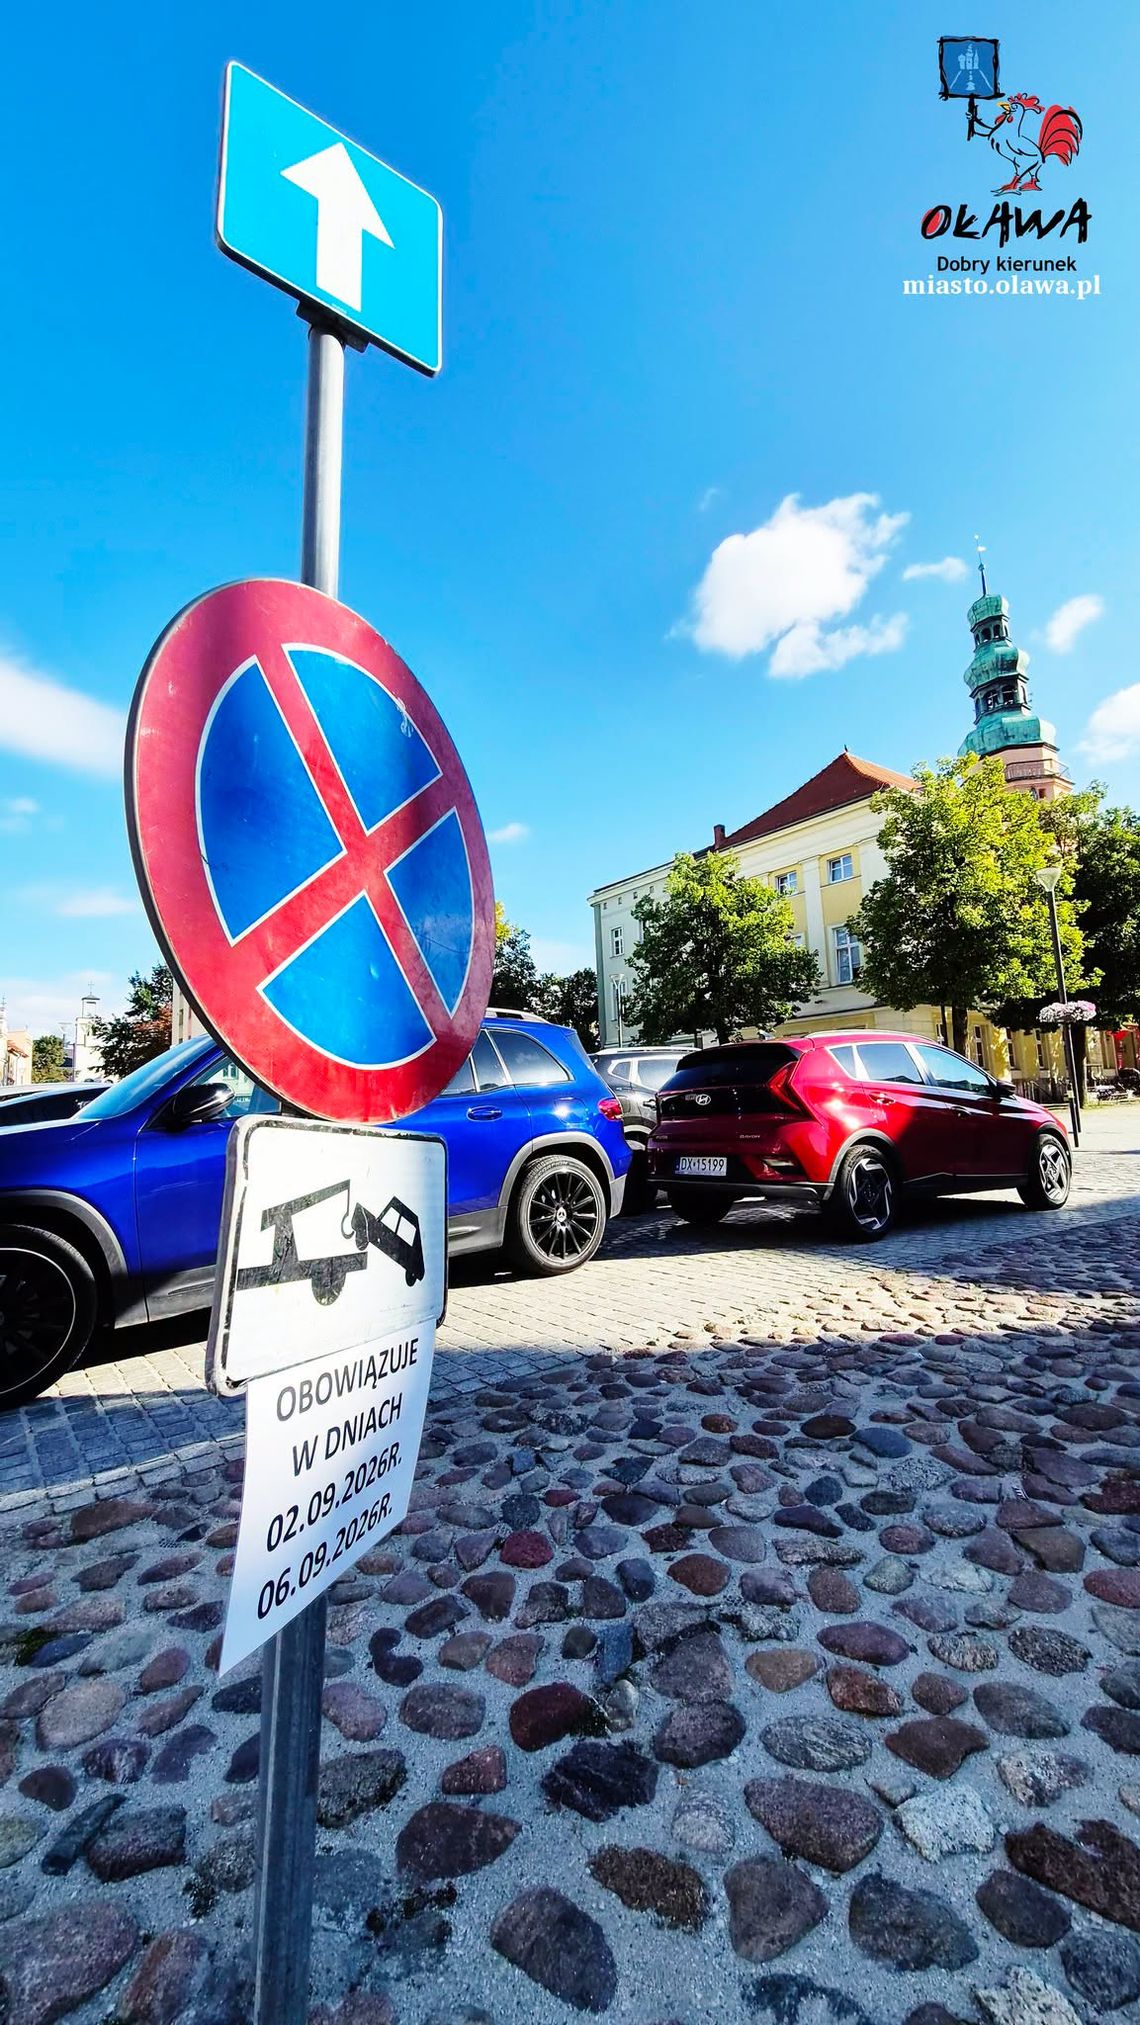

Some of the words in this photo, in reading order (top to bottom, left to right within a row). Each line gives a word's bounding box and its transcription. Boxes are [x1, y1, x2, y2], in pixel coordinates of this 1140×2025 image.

[276, 1338, 419, 1422] OBOWIĄZUJE
[292, 1435, 318, 1476] W
[325, 1393, 402, 1461] DNIACH
[266, 1442, 402, 1552] 02.09.2026R.
[257, 1492, 393, 1620] 06.09.2026R.
